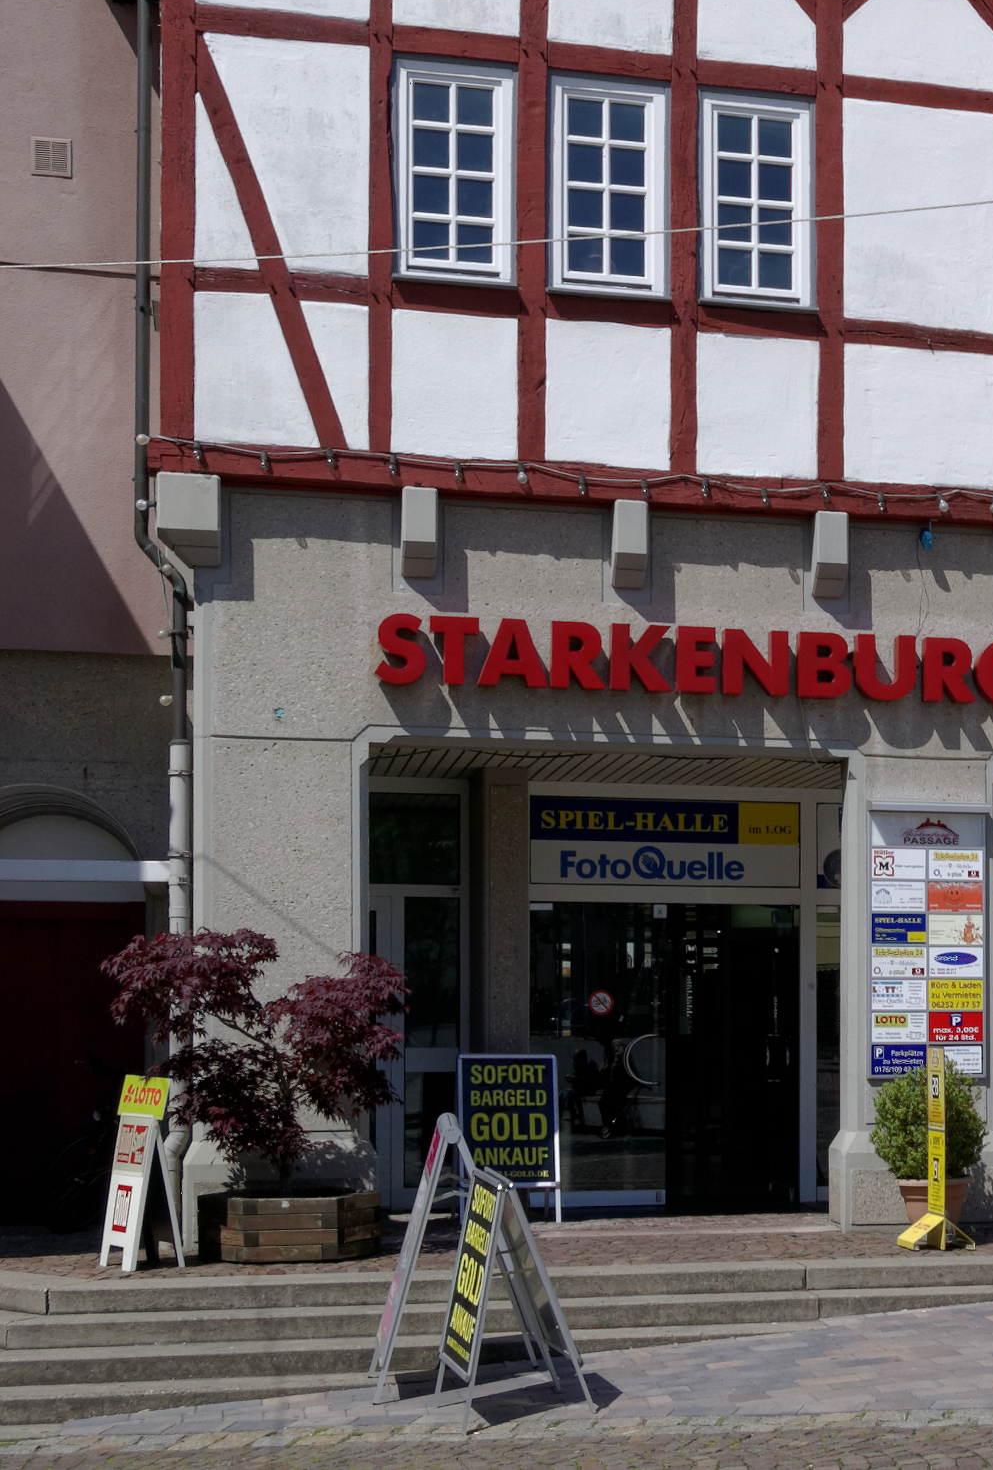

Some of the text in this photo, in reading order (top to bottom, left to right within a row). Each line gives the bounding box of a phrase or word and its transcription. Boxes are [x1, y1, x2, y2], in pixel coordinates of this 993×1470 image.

[540, 809, 729, 834] SPIEL-HALLE
[748, 823, 762, 834] im
[903, 837, 959, 846] PASSAGE
[560, 845, 745, 881] FotoQuelle
[879, 862, 889, 871] M
[930, 981, 951, 989] Büro
[951, 981, 957, 989] &
[959, 981, 982, 989] Laden
[942, 991, 982, 999] Vermieten
[931, 1001, 954, 1009] 06252
[875, 1015, 907, 1025] LOTTO
[891, 1049, 924, 1058] Parkplätze
[470, 1064, 546, 1085] SOFORT
[134, 1087, 163, 1107] LOTTO
[470, 1089, 547, 1107] BARGELD
[470, 1112, 548, 1141] GOLD
[473, 1146, 549, 1166] ANKAUF
[471, 1183, 497, 1224] SOFORT
[464, 1218, 491, 1257] BARGELD
[457, 1252, 485, 1307] GOLD
[449, 1302, 477, 1344] ANKAUF
